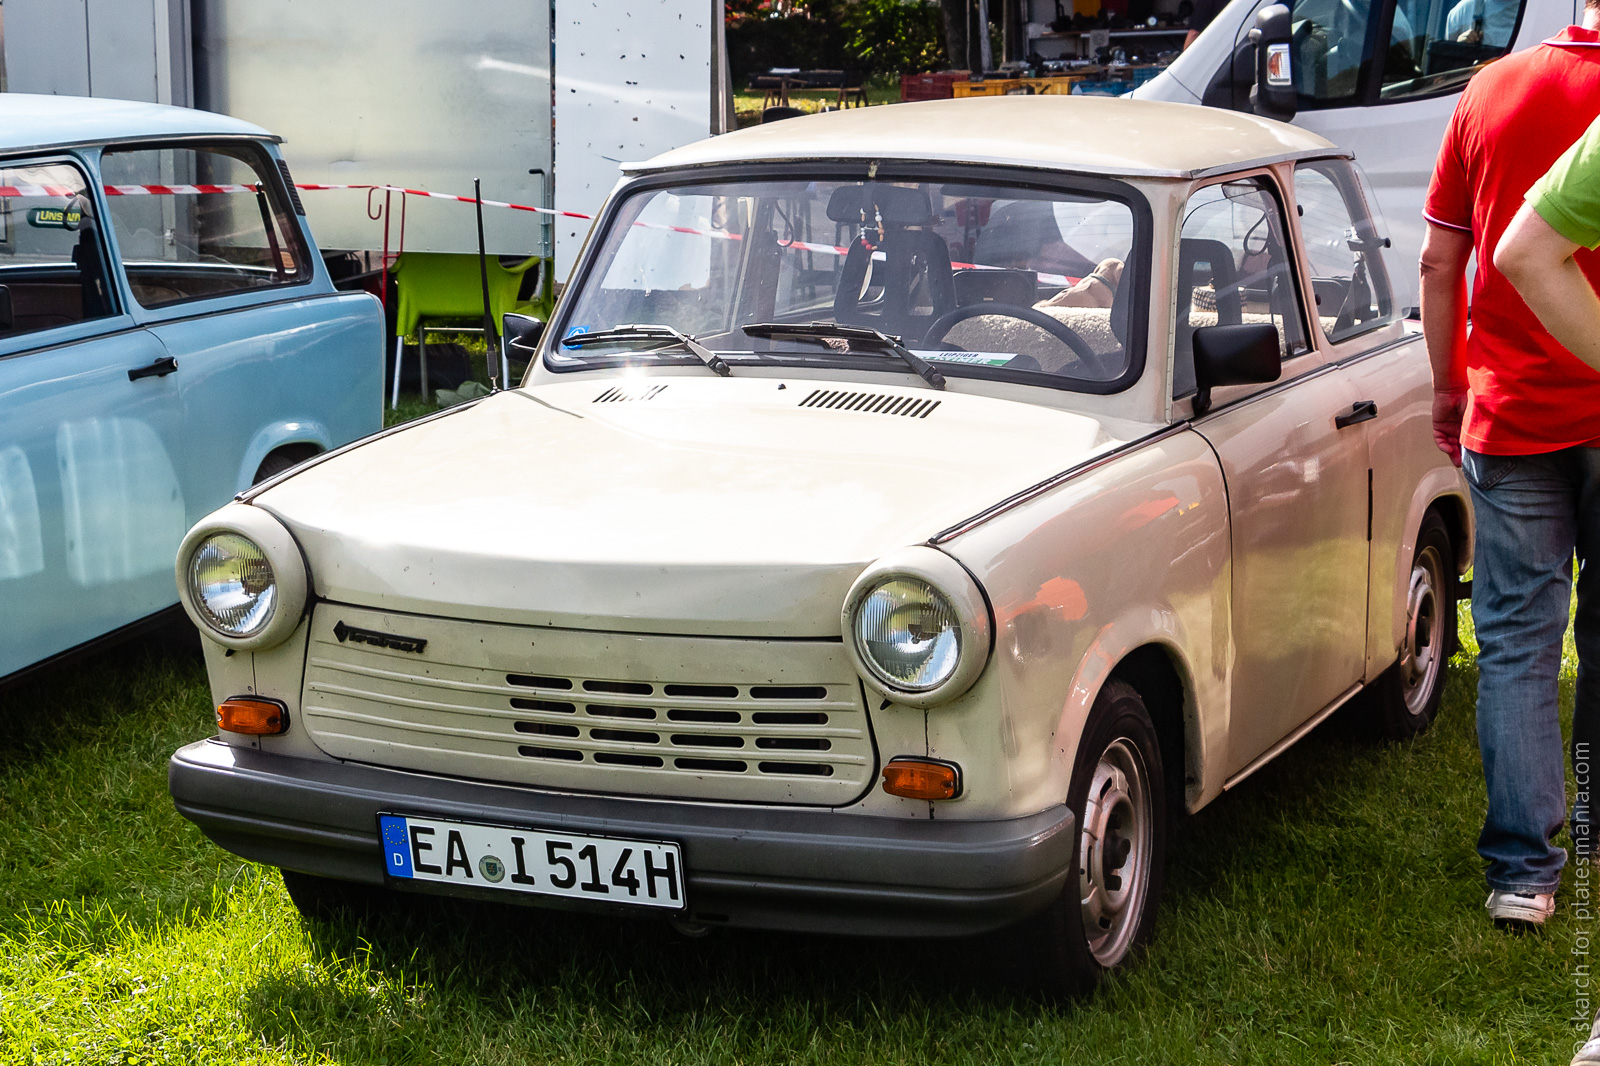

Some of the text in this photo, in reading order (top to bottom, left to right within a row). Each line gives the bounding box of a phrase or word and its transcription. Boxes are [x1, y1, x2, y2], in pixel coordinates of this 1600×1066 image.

[40, 210, 81, 222] UNSNN
[393, 852, 404, 866] D
[410, 825, 679, 900] EA I 514H
